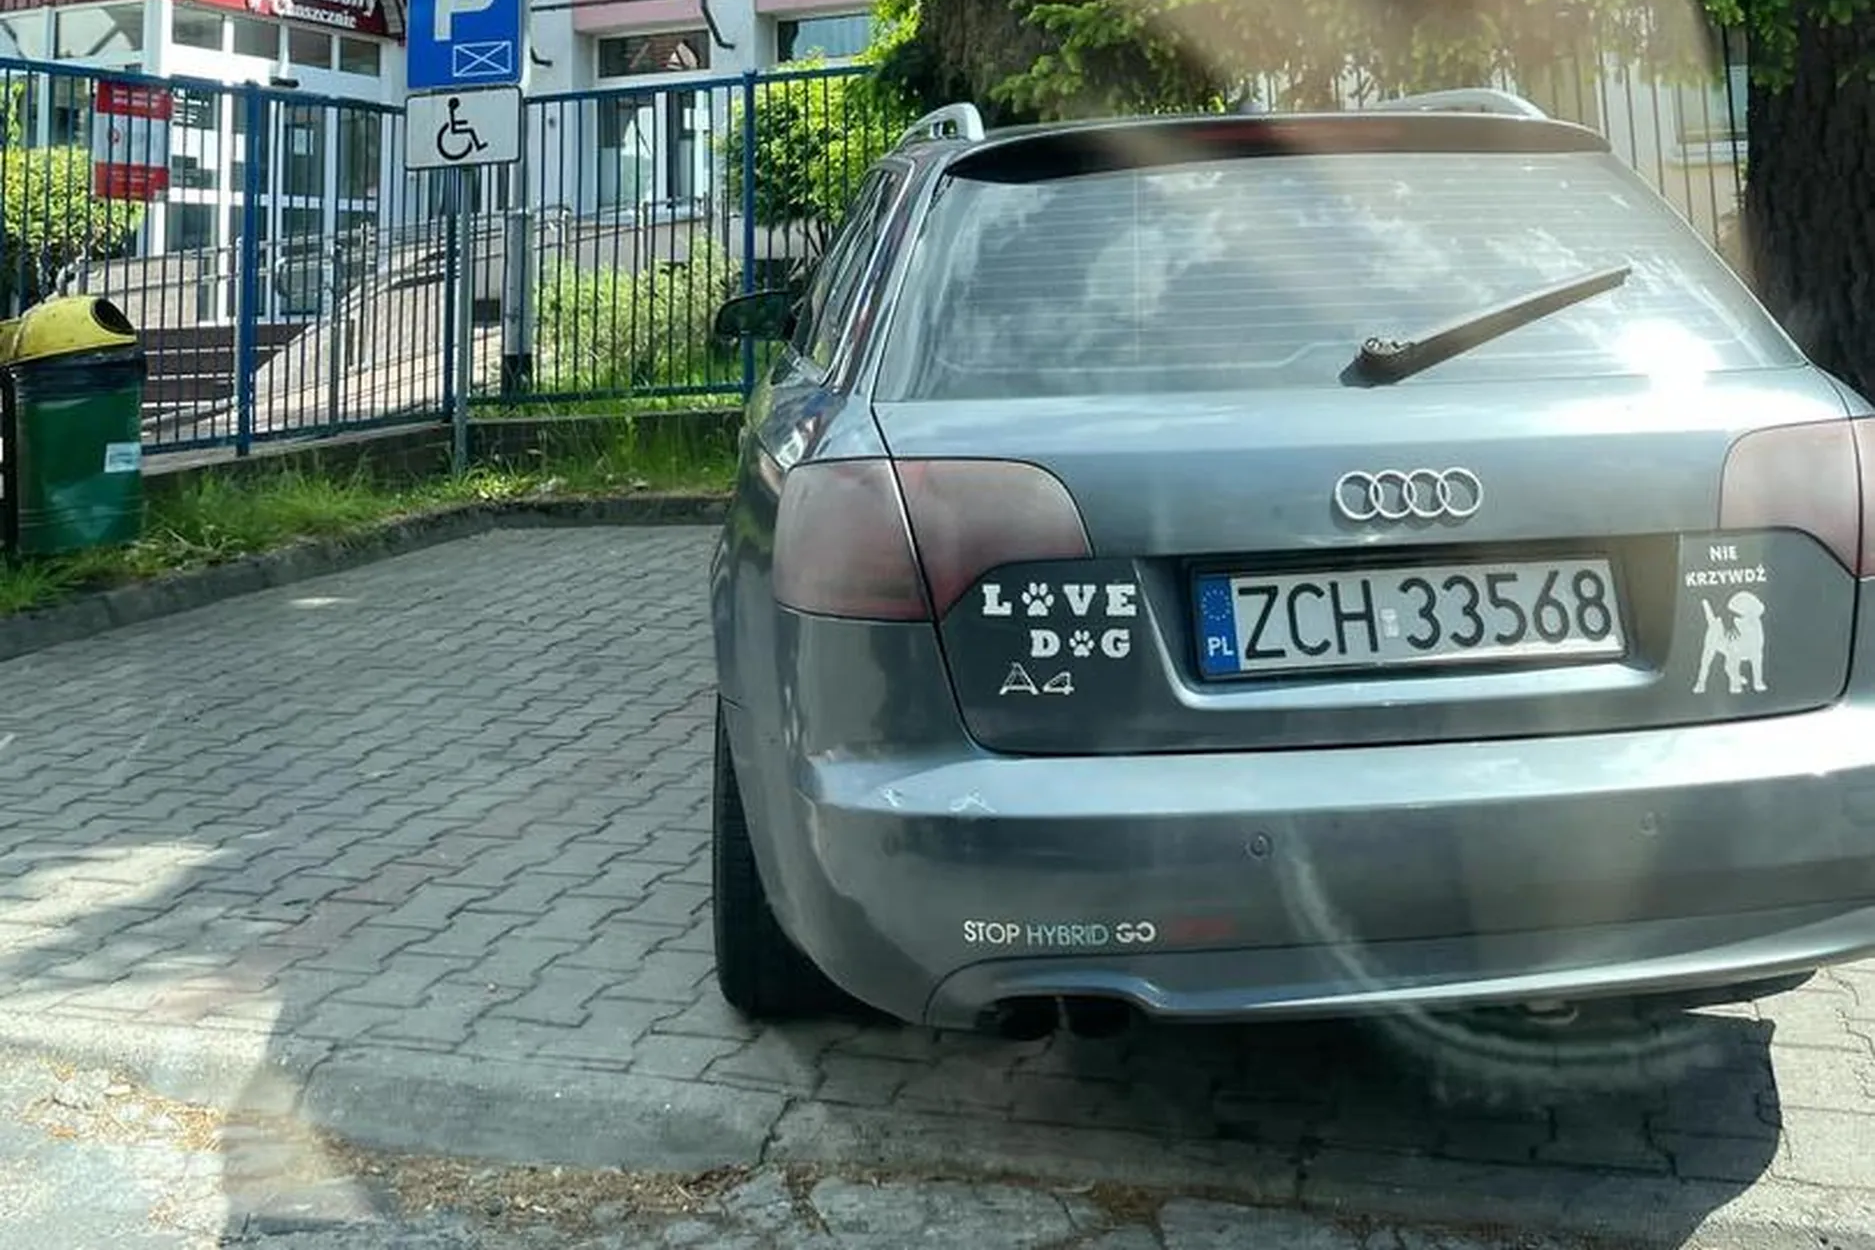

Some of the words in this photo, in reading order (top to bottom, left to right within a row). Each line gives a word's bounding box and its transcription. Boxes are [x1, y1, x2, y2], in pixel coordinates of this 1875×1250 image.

[1709, 546, 1738, 562] NIE
[1207, 635, 1234, 657] PL
[1238, 578, 1379, 659] ZCH
[1398, 568, 1613, 651] 33568
[998, 661, 1075, 696] A4
[963, 919, 1020, 944] STOP
[1026, 923, 1109, 946] HYBRID
[1115, 920, 1157, 944] GO
